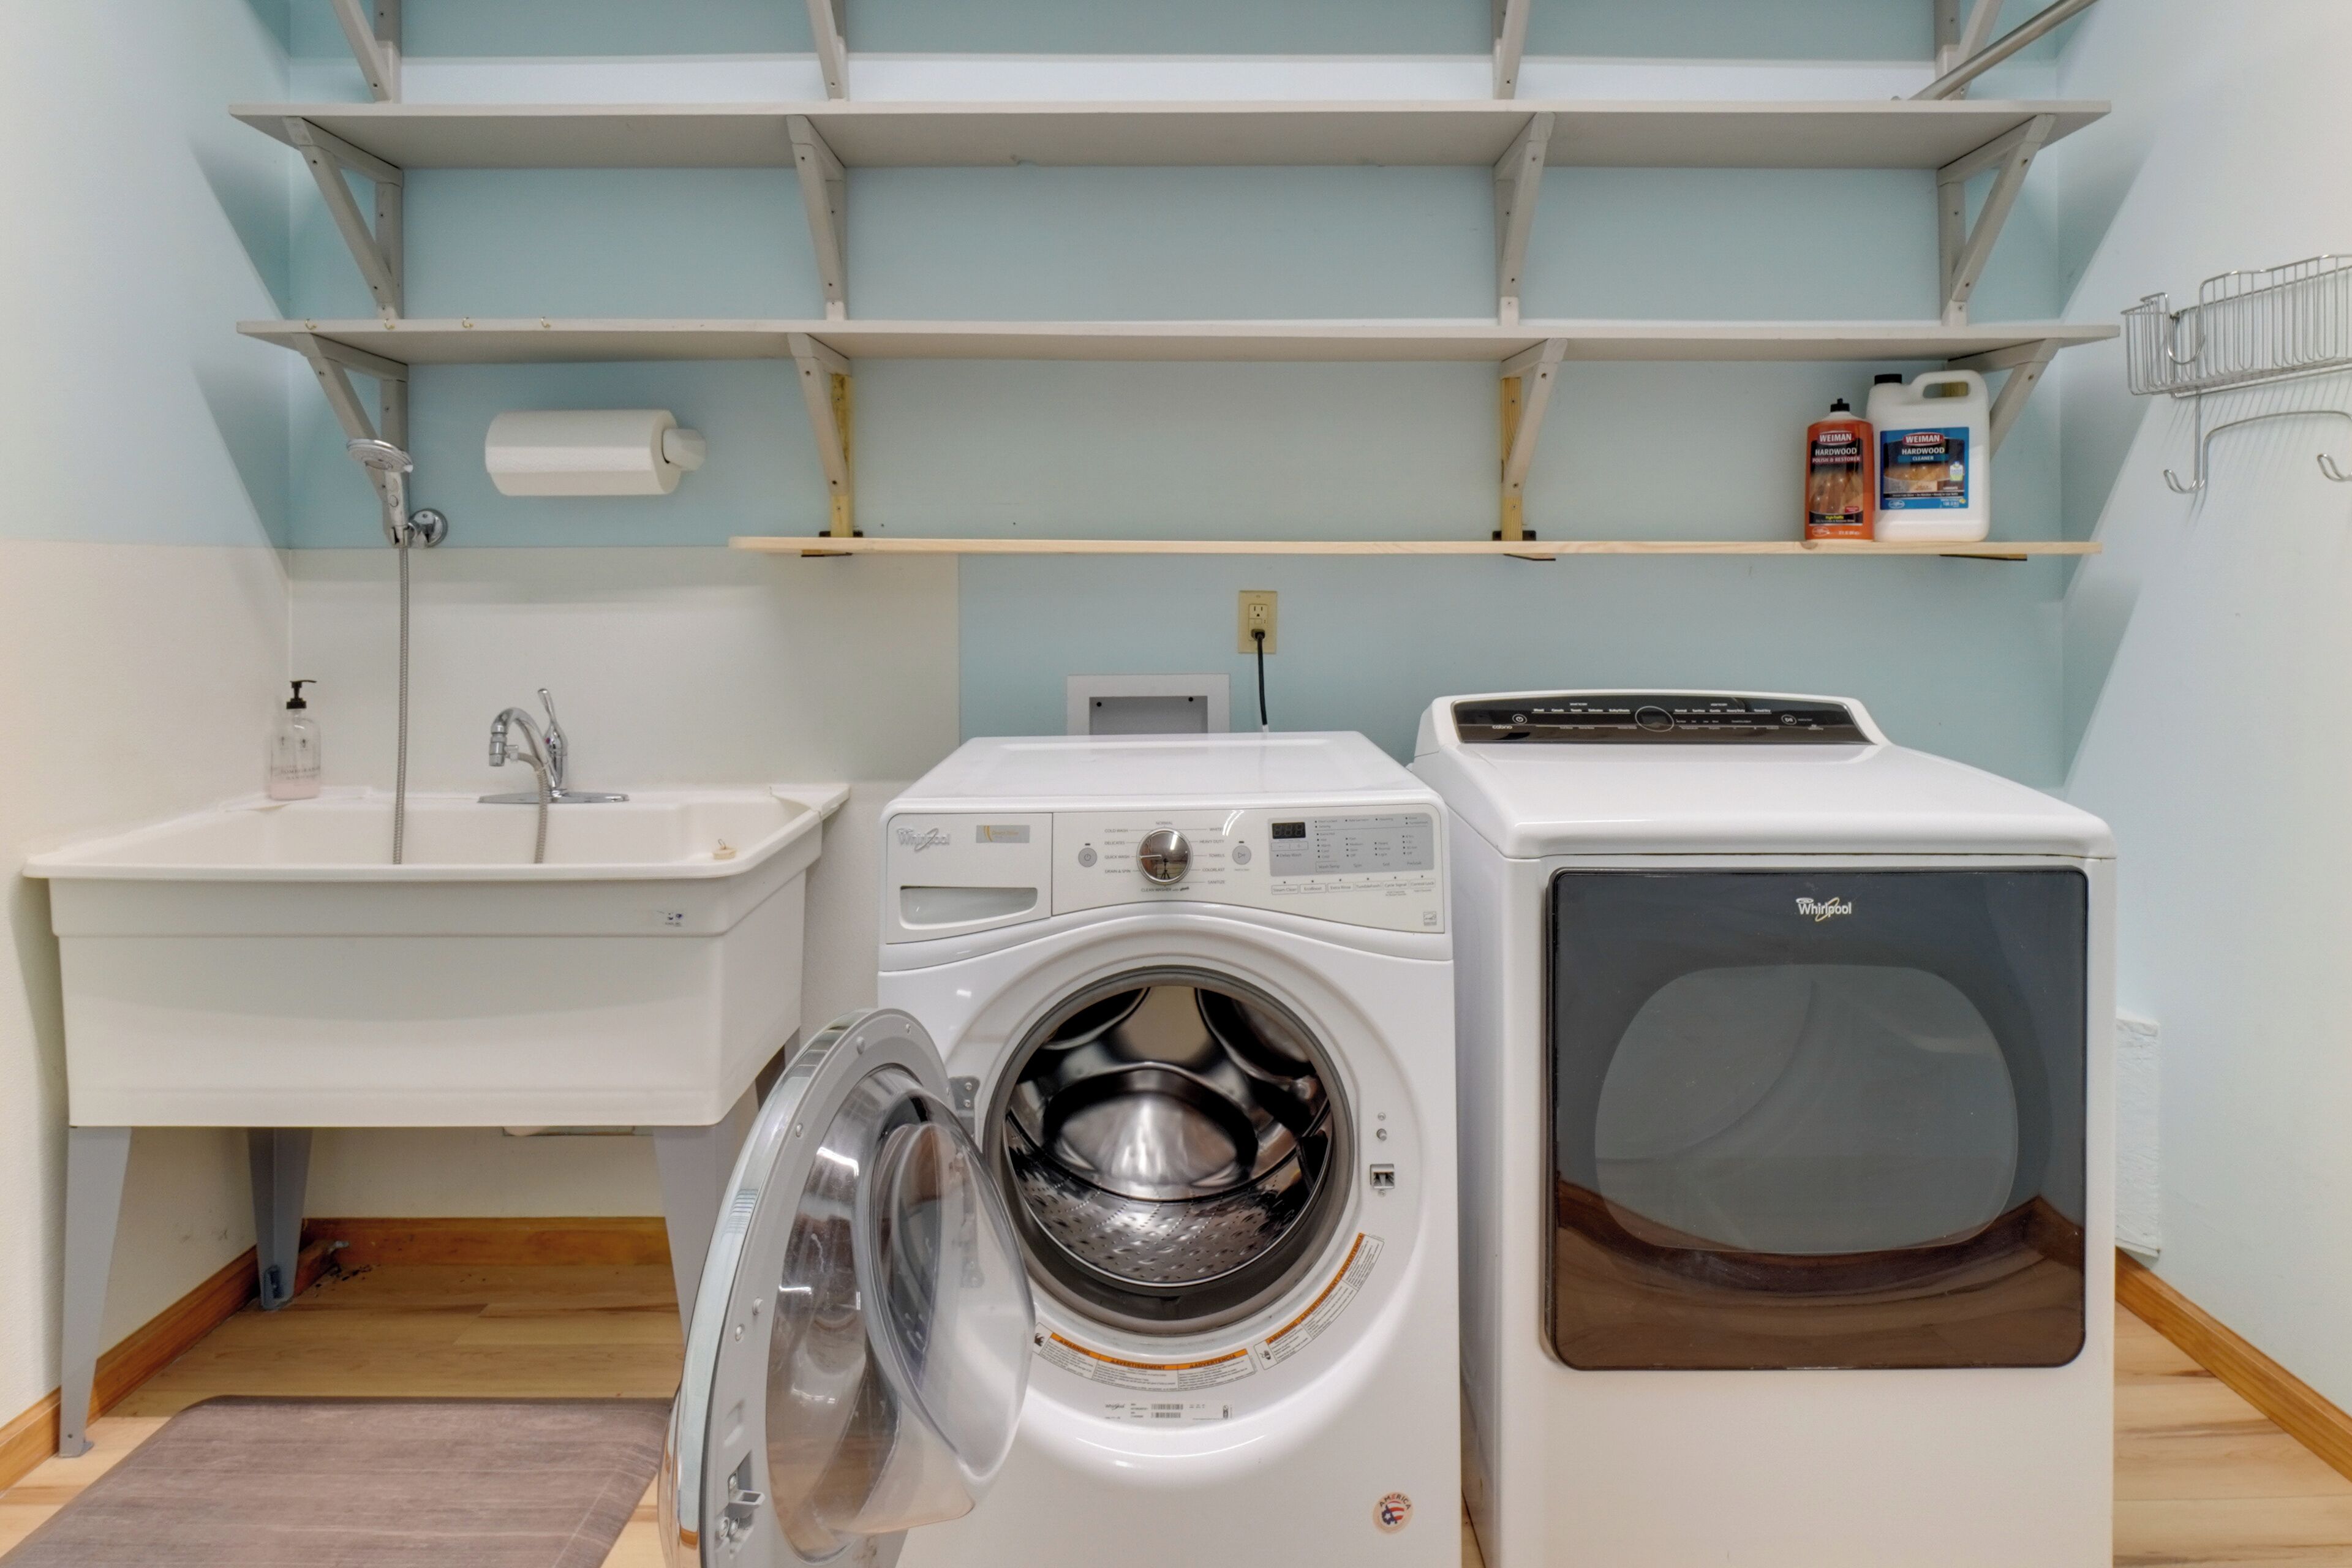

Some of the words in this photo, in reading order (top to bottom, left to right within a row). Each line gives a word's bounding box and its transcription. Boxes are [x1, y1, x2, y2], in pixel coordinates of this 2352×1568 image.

[1819, 433, 1852, 442] WEIMAN
[1905, 434, 1940, 443] WEIMAN
[1815, 447, 1857, 456] HARDWOOD
[1796, 898, 1852, 920] Whirlpool
[1063, 1340, 1090, 1356] WARNING
[1116, 1360, 1164, 1370] AVERTISSEMENT
[1194, 1353, 1236, 1368] ADVERTENCIA
[1379, 1494, 1411, 1510] AMERICA
